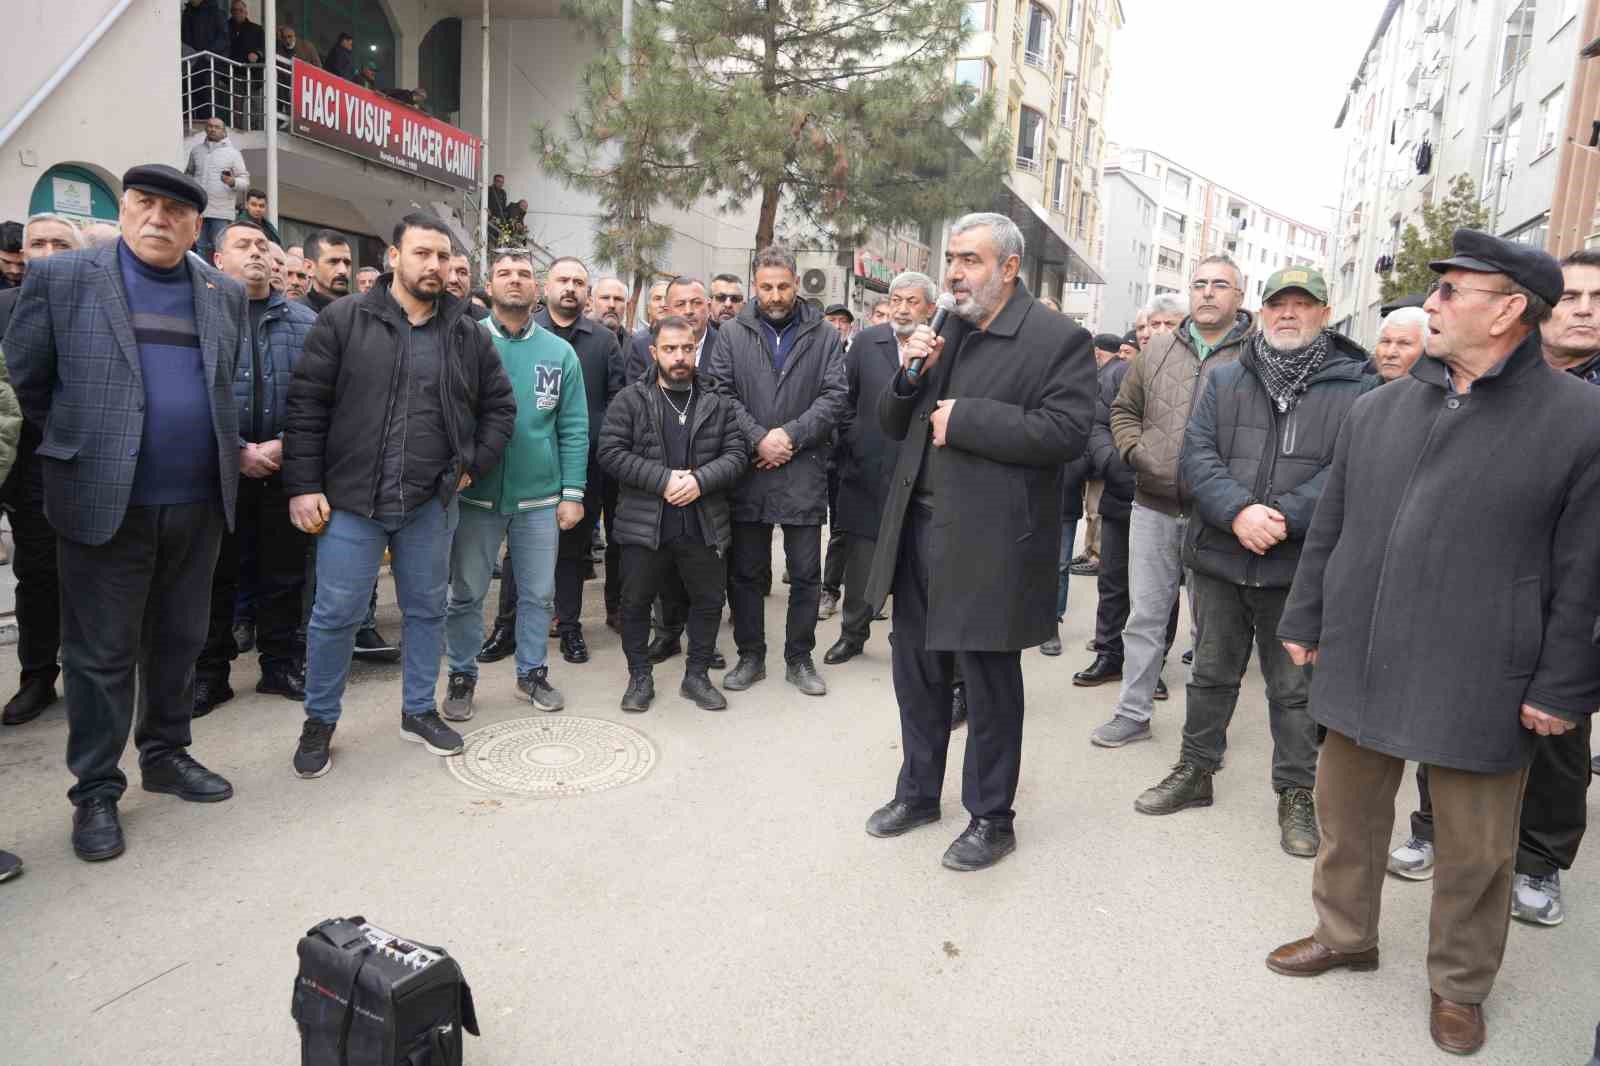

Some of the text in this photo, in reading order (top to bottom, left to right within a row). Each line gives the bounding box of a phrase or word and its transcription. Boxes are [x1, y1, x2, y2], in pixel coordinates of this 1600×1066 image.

[302, 76, 340, 130] HACI
[344, 92, 392, 148] YUSUF
[402, 118, 443, 169] HACER
[534, 364, 562, 398] M
